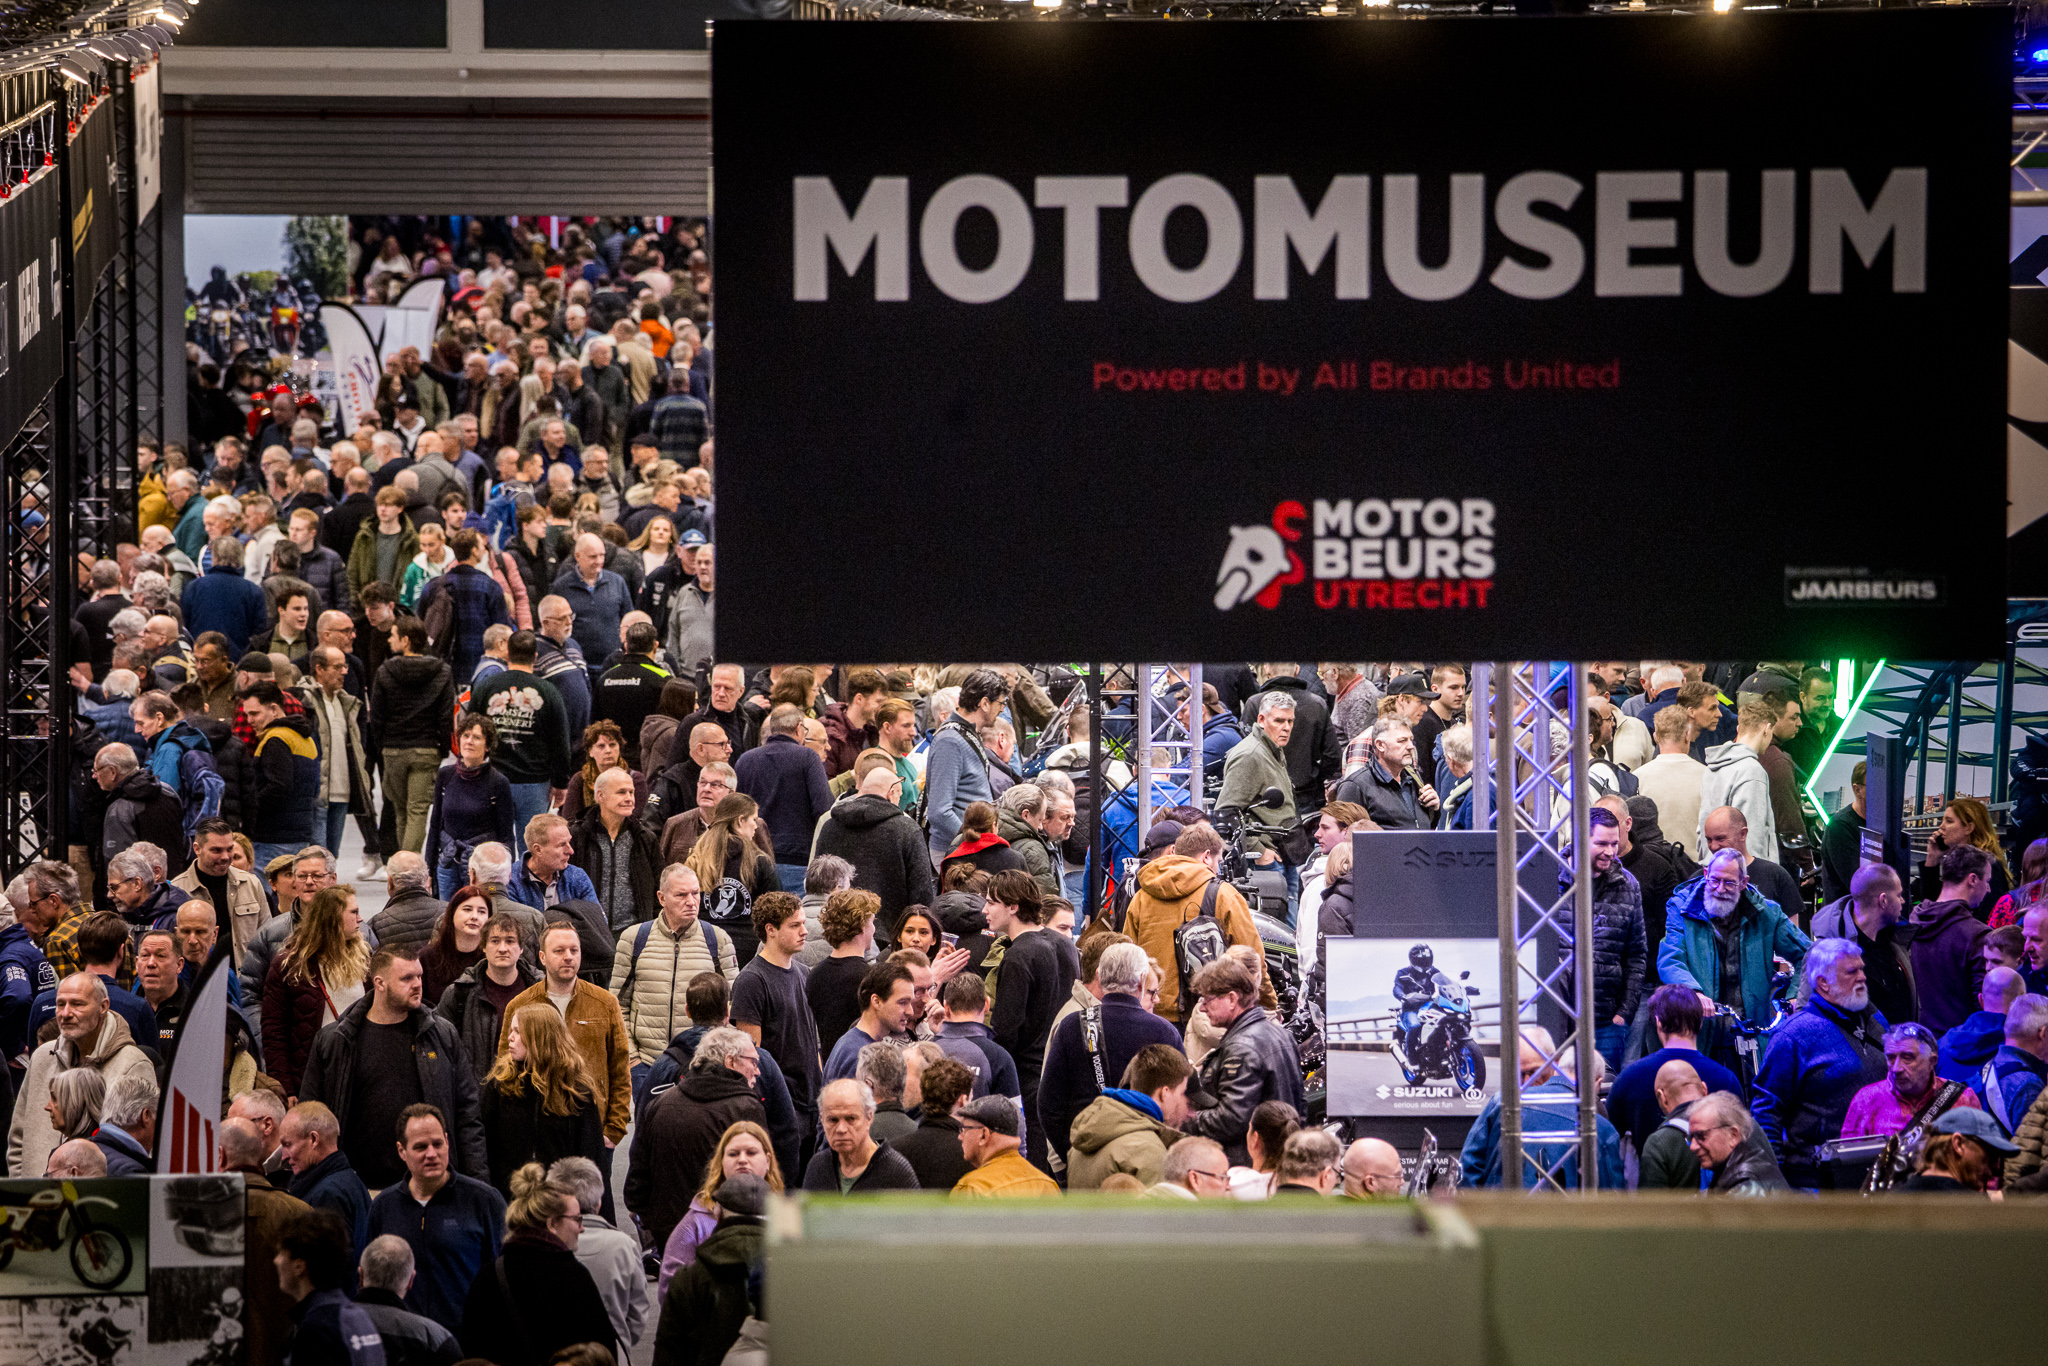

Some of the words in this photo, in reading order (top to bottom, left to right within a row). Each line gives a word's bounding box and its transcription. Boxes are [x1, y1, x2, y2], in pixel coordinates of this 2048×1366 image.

[793, 168, 1928, 303] MOTOMUSEUM
[1093, 363, 1246, 392] Powered
[1258, 363, 1298, 396] by
[1313, 363, 1357, 389] All
[1371, 361, 1492, 391] Brands
[1504, 359, 1621, 390] United
[1312, 498, 1496, 537] MOTOR
[1312, 538, 1496, 579] BEURS
[1313, 581, 1494, 610] UTRECHT
[1791, 580, 1938, 601] JAARBEURS
[604, 677, 641, 686] Kawasaki
[1262, 936, 1287, 946] Vulcan
[1394, 1087, 1453, 1097] SUZUKI
